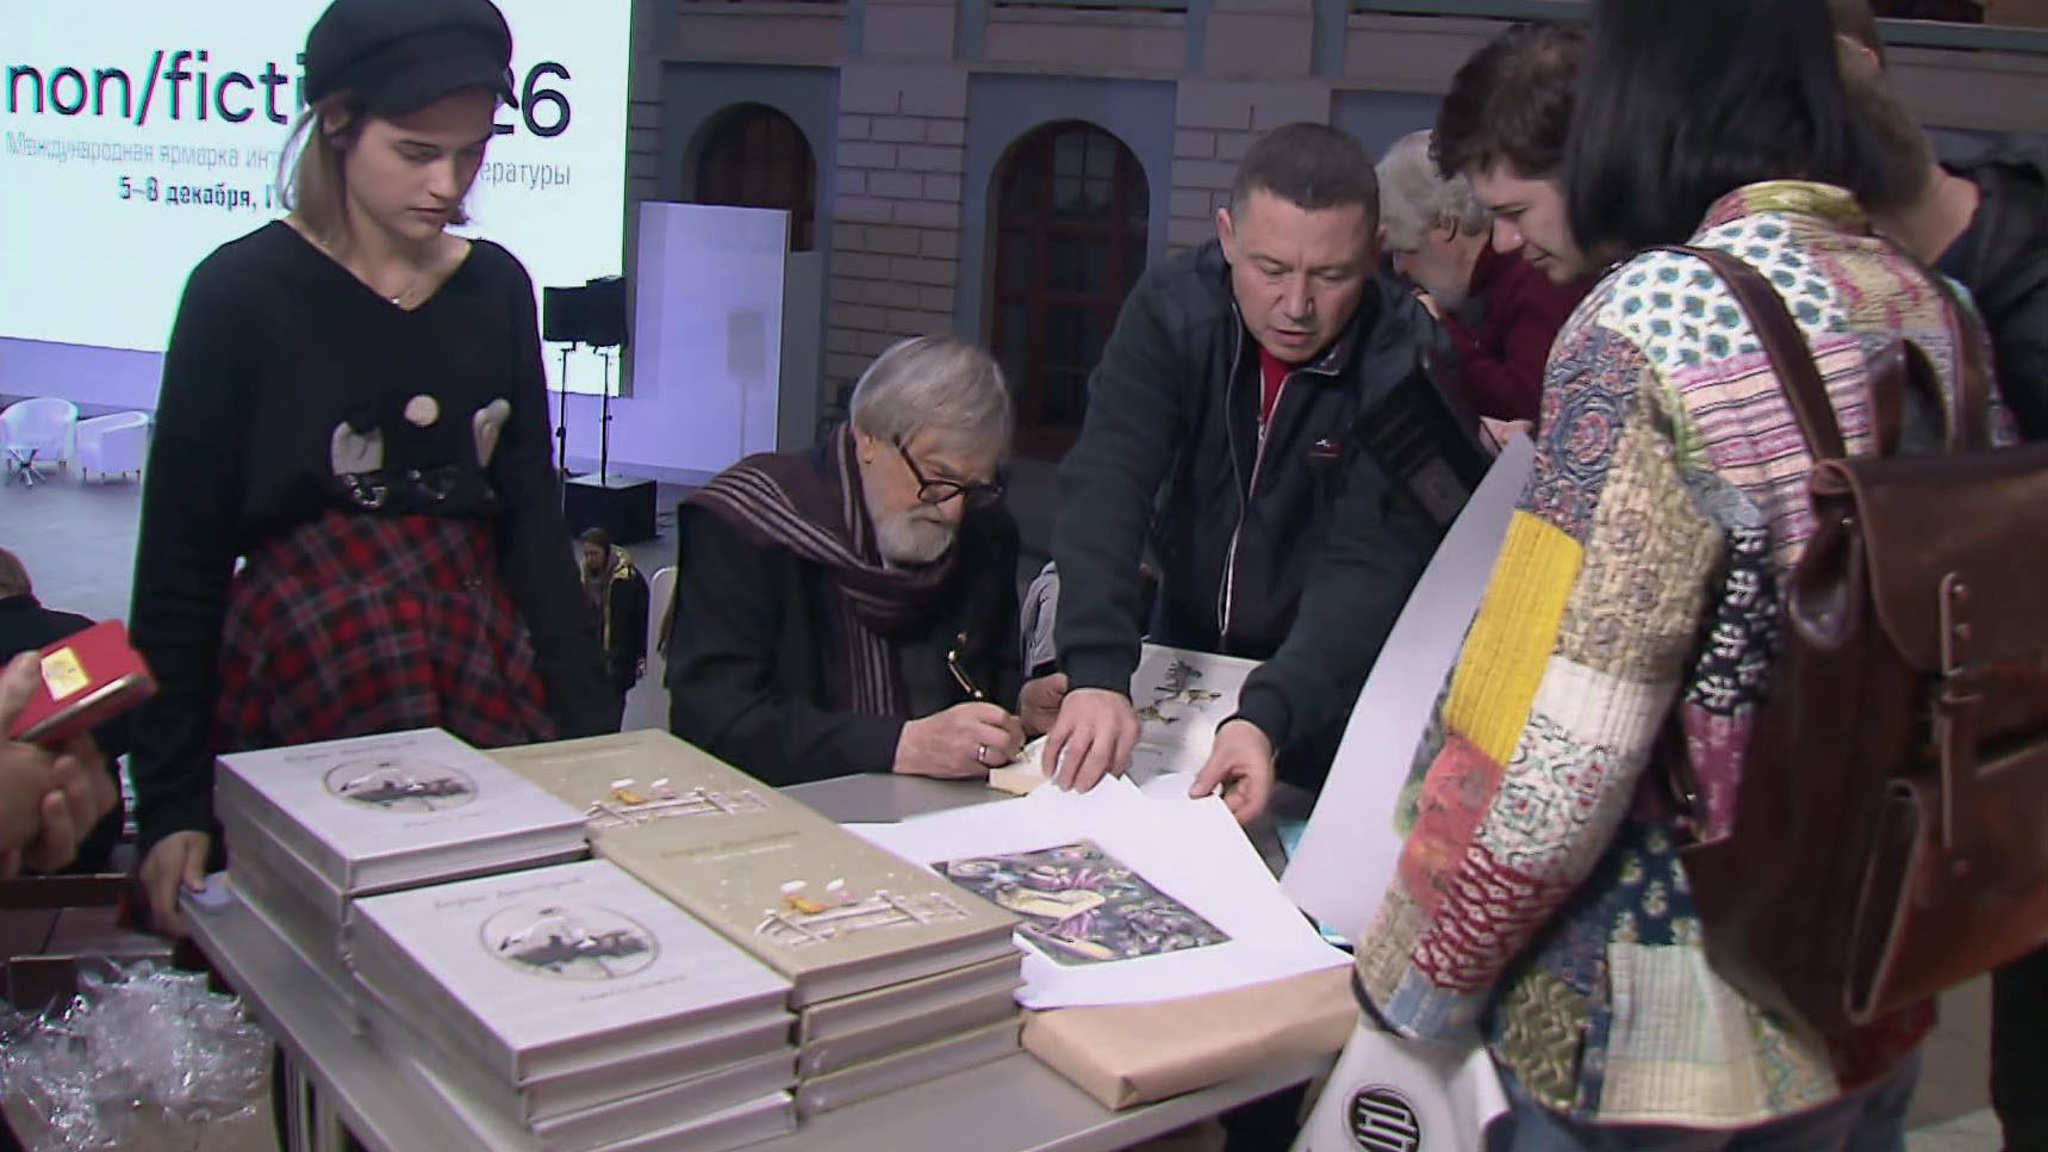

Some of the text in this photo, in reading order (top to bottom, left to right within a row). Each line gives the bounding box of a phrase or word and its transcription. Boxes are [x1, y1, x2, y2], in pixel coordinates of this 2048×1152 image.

[6, 49, 571, 137] non/ficti 6
[5, 131, 153, 164] Международная
[159, 144, 238, 168] ярмарка
[479, 161, 570, 190] ературы
[165, 182, 257, 211] декабря,
